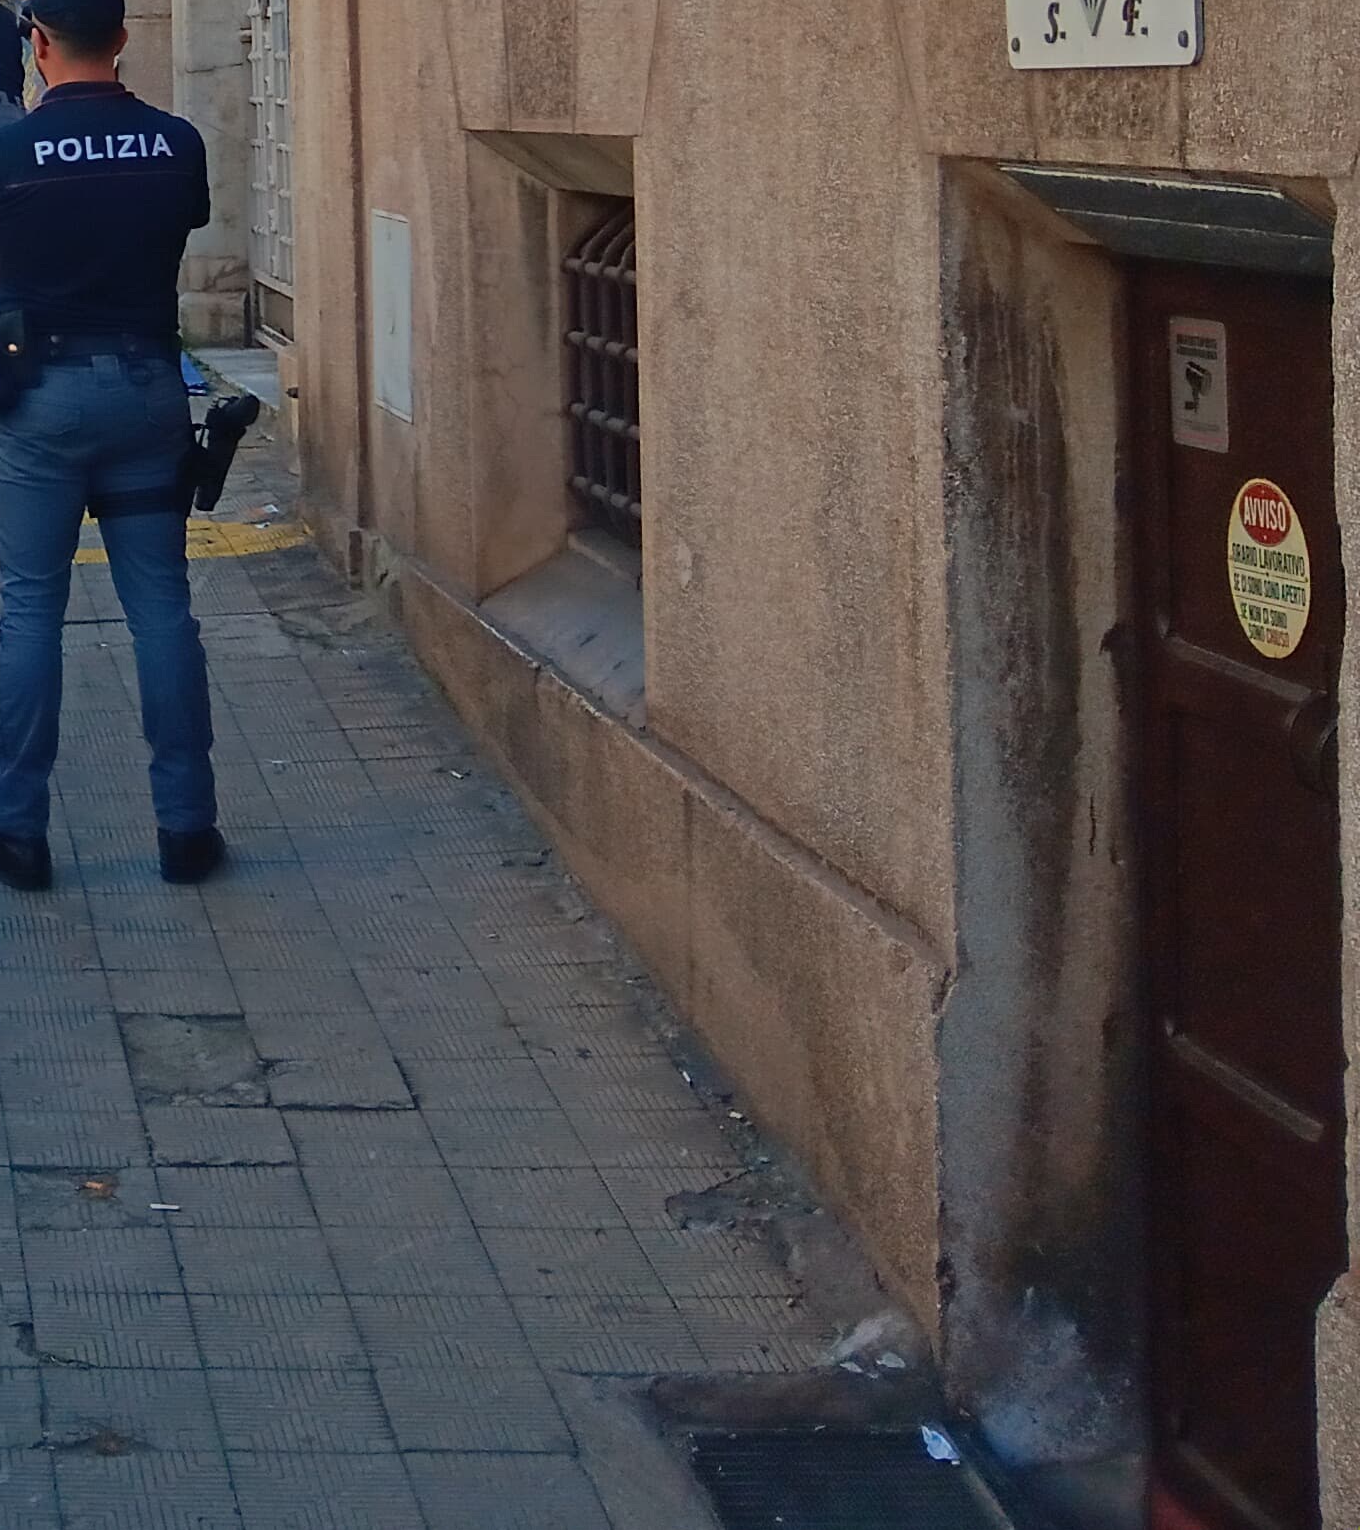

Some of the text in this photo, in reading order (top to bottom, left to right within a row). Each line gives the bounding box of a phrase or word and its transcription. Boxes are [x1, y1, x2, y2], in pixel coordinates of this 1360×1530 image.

[1044, 1, 1066, 44] S.
[35, 133, 174, 165] POLIZIA
[1243, 496, 1287, 532] AVVISO
[1259, 548, 1305, 577] LAVORATIVO
[1281, 583, 1306, 606] APERTO
